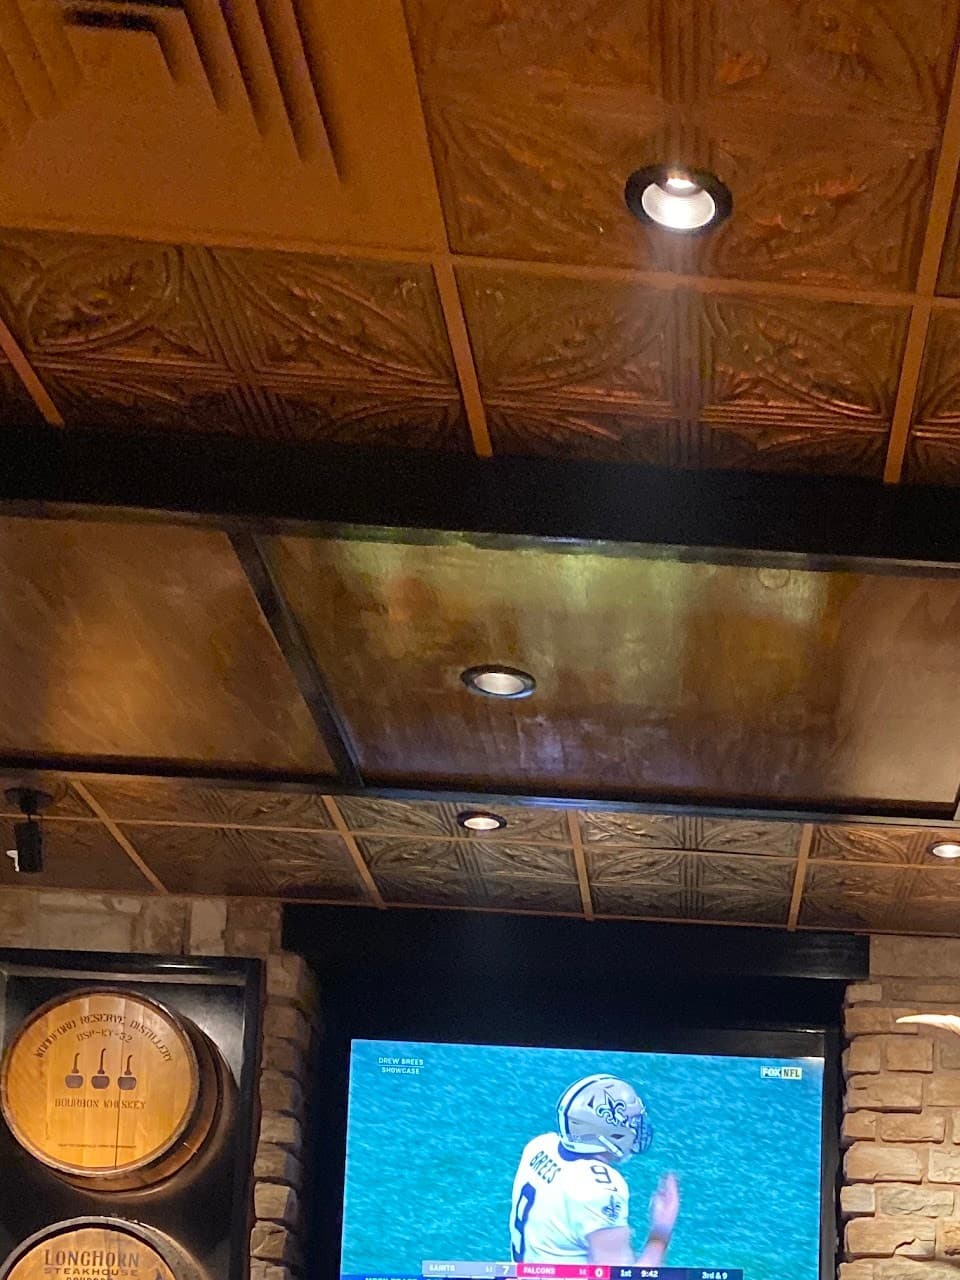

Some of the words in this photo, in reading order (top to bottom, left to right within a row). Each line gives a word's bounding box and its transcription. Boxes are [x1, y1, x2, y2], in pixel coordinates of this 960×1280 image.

[80, 1012, 127, 1026] RESERVE
[130, 1018, 174, 1063] DISTILLERY
[378, 1057, 400, 1065] DREW
[401, 1058, 424, 1066] BREES
[381, 1066, 420, 1075] SHOWCASE
[762, 1066, 781, 1077] FOX
[783, 1068, 801, 1078] NFL
[55, 1098, 99, 1109] BOURBON
[103, 1100, 147, 1110] WHISKEY
[529, 1150, 562, 1185] BREES
[45, 1249, 139, 1267] LONGHORN
[43, 1267, 139, 1277] STEAKHOUSE
[502, 1264, 509, 1274] 7
[523, 1266, 556, 1275] FALCONS
[641, 1269, 659, 1278] 9:42
[702, 1271, 715, 1280] 3rd
[722, 1272, 728, 1280] 9
